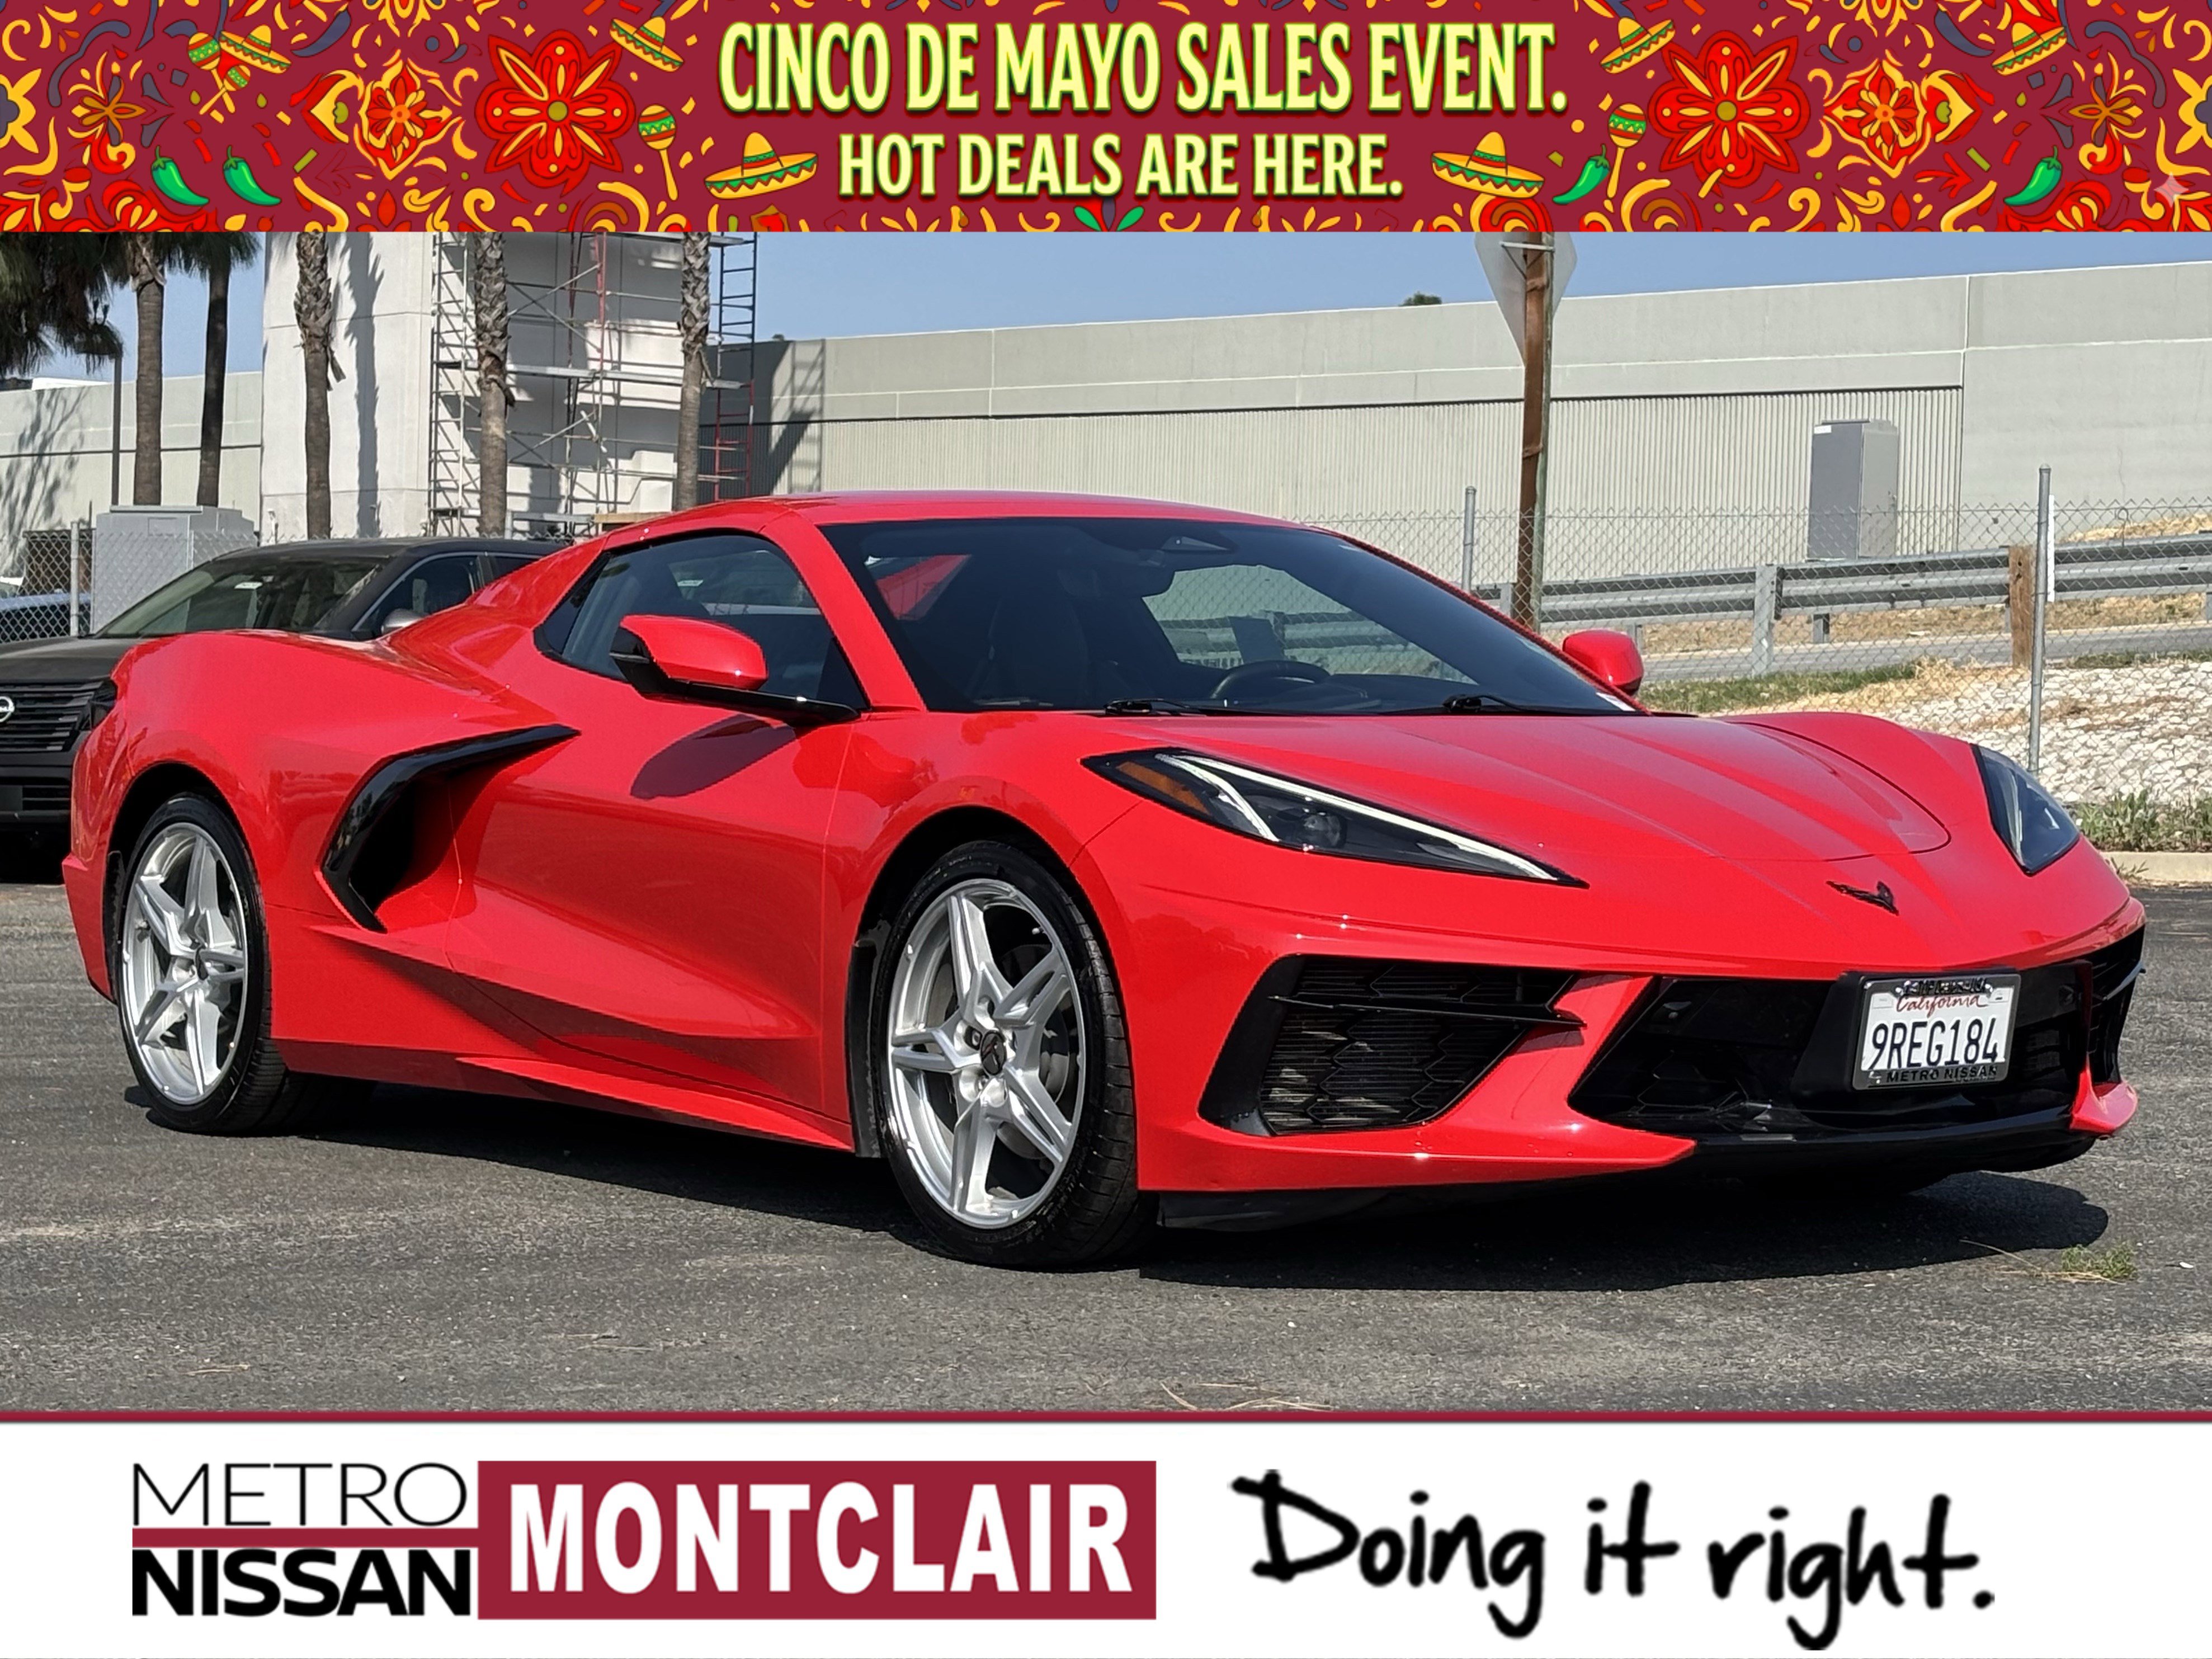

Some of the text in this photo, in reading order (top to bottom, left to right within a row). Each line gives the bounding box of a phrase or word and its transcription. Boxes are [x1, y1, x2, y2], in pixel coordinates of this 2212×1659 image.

[1896, 993, 1988, 1018] California
[1869, 1017, 1998, 1069] 9REG184
[1886, 1064, 1998, 1083] METRO NISSAN
